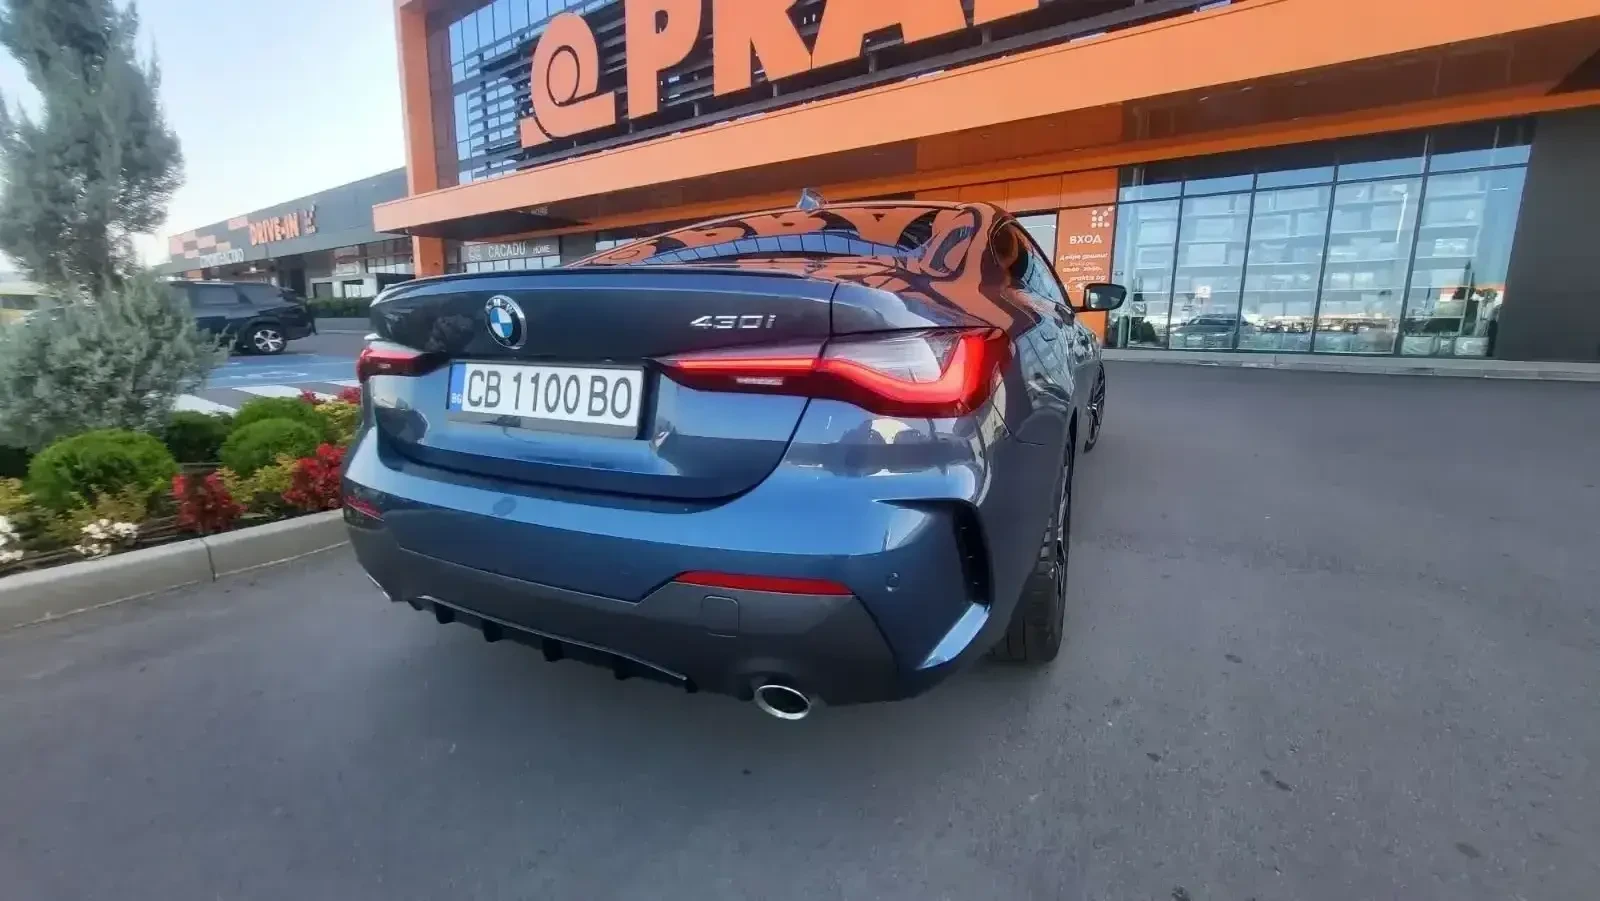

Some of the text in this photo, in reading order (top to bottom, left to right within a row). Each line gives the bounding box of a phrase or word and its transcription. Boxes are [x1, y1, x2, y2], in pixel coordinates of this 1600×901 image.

[1069, 234, 1103, 245] ВХОД
[487, 241, 527, 258] CACADU
[689, 314, 777, 330] 430i
[467, 369, 502, 408] CB
[512, 371, 581, 415] 1100
